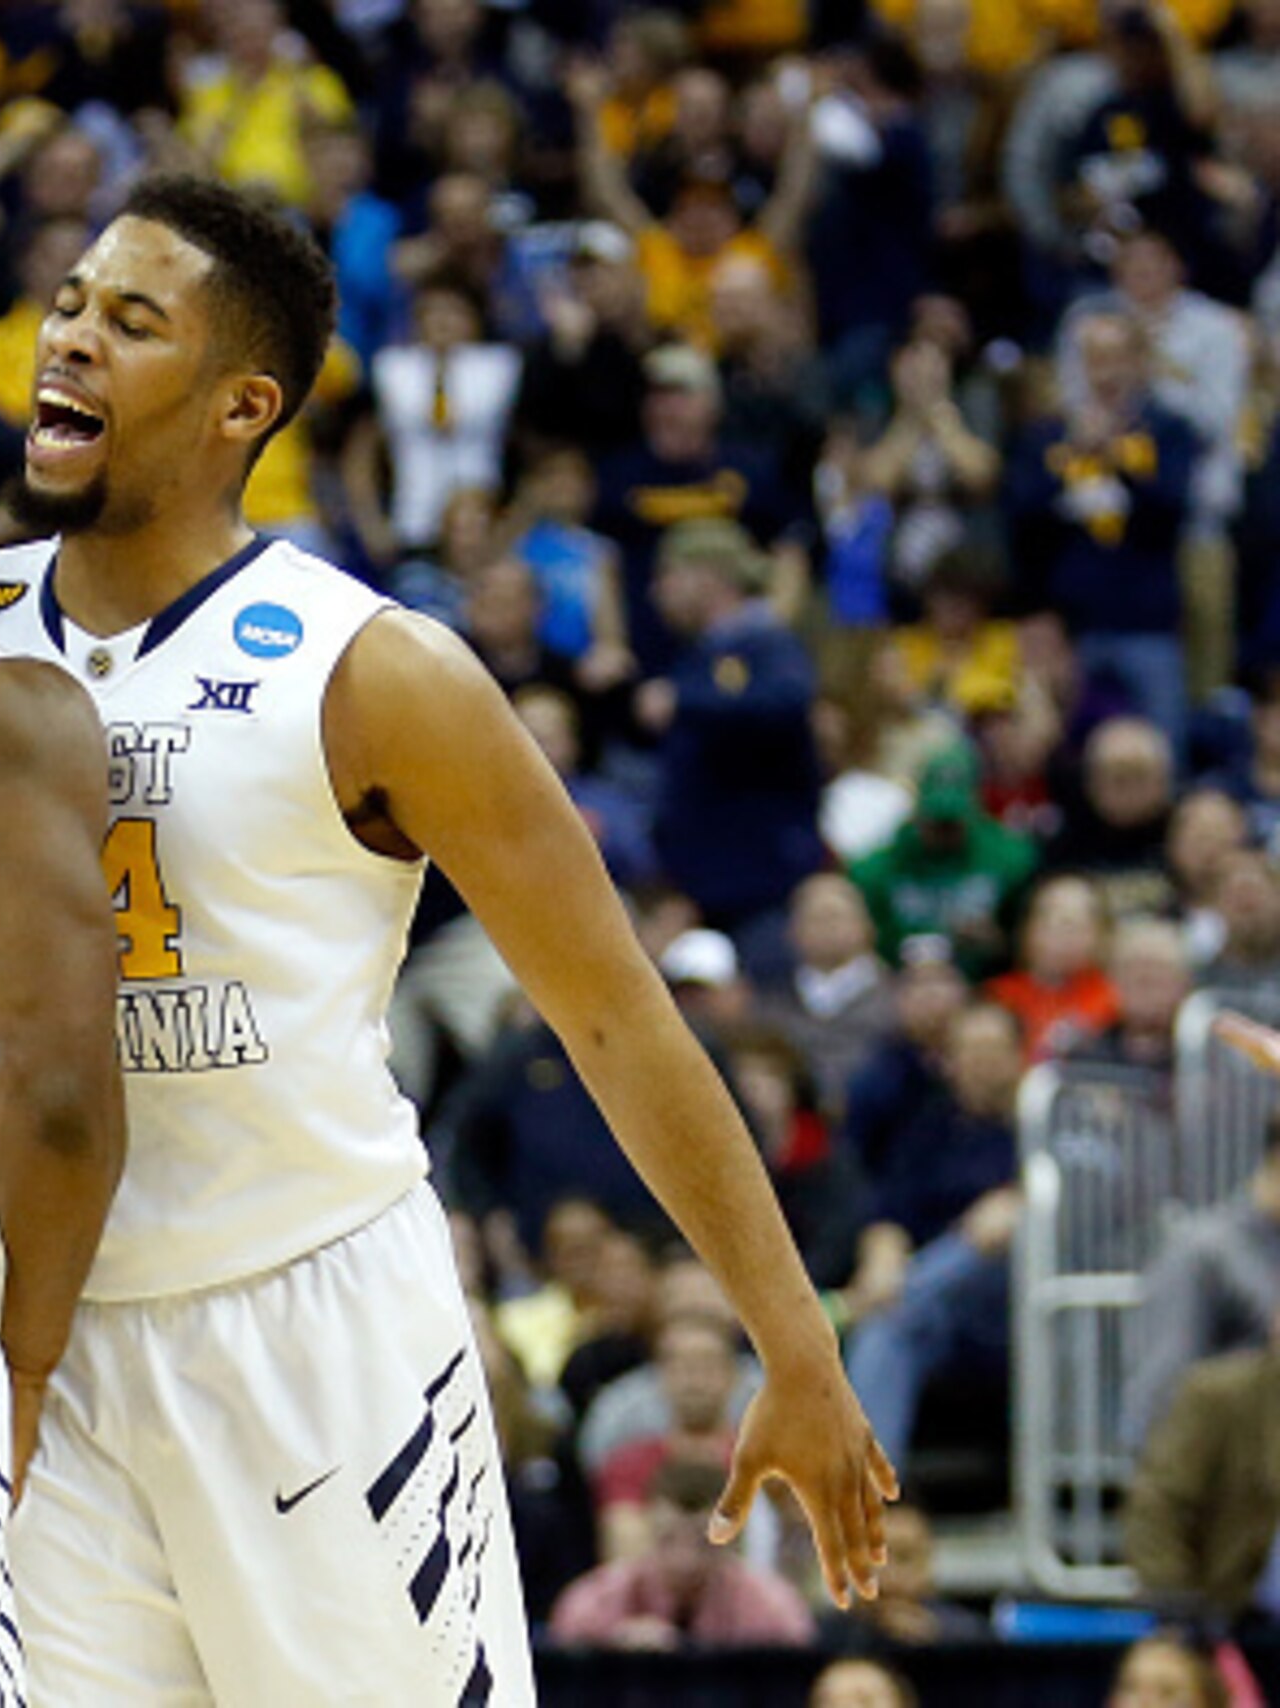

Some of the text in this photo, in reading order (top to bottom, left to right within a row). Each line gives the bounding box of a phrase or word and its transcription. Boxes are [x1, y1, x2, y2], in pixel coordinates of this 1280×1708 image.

[106, 721, 190, 804] ST
[99, 816, 182, 980] 4
[116, 980, 269, 1071] INIA
